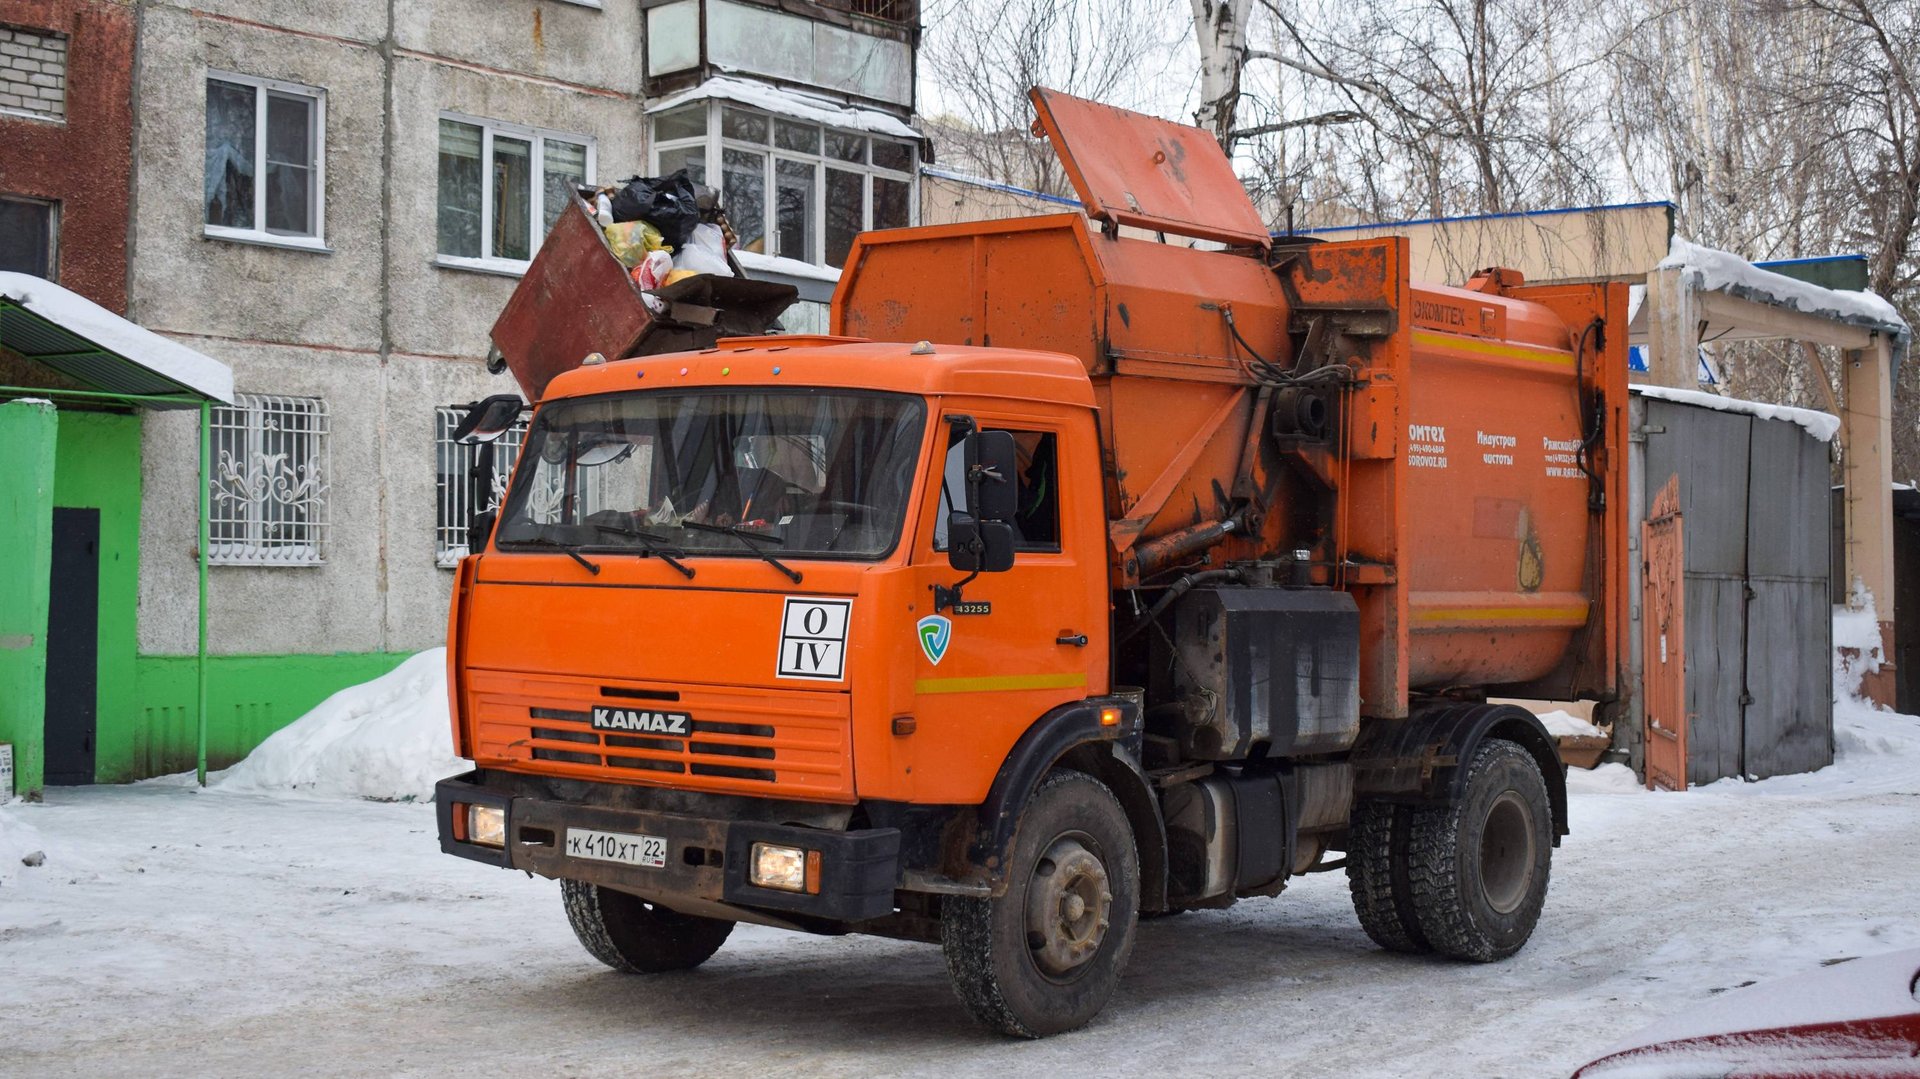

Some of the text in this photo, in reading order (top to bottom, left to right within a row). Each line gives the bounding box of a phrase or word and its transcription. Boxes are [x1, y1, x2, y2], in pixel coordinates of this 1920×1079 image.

[1477, 430, 1517, 449] Индустрия
[1408, 455, 1447, 468] SOROVOZ.RU
[1483, 453, 1514, 466] чистоты
[957, 605, 989, 613] 43255
[792, 641, 831, 672] IV
[594, 708, 686, 734] KAMAZ
[644, 841, 661, 858] 22
[642, 857, 655, 865] RUS
